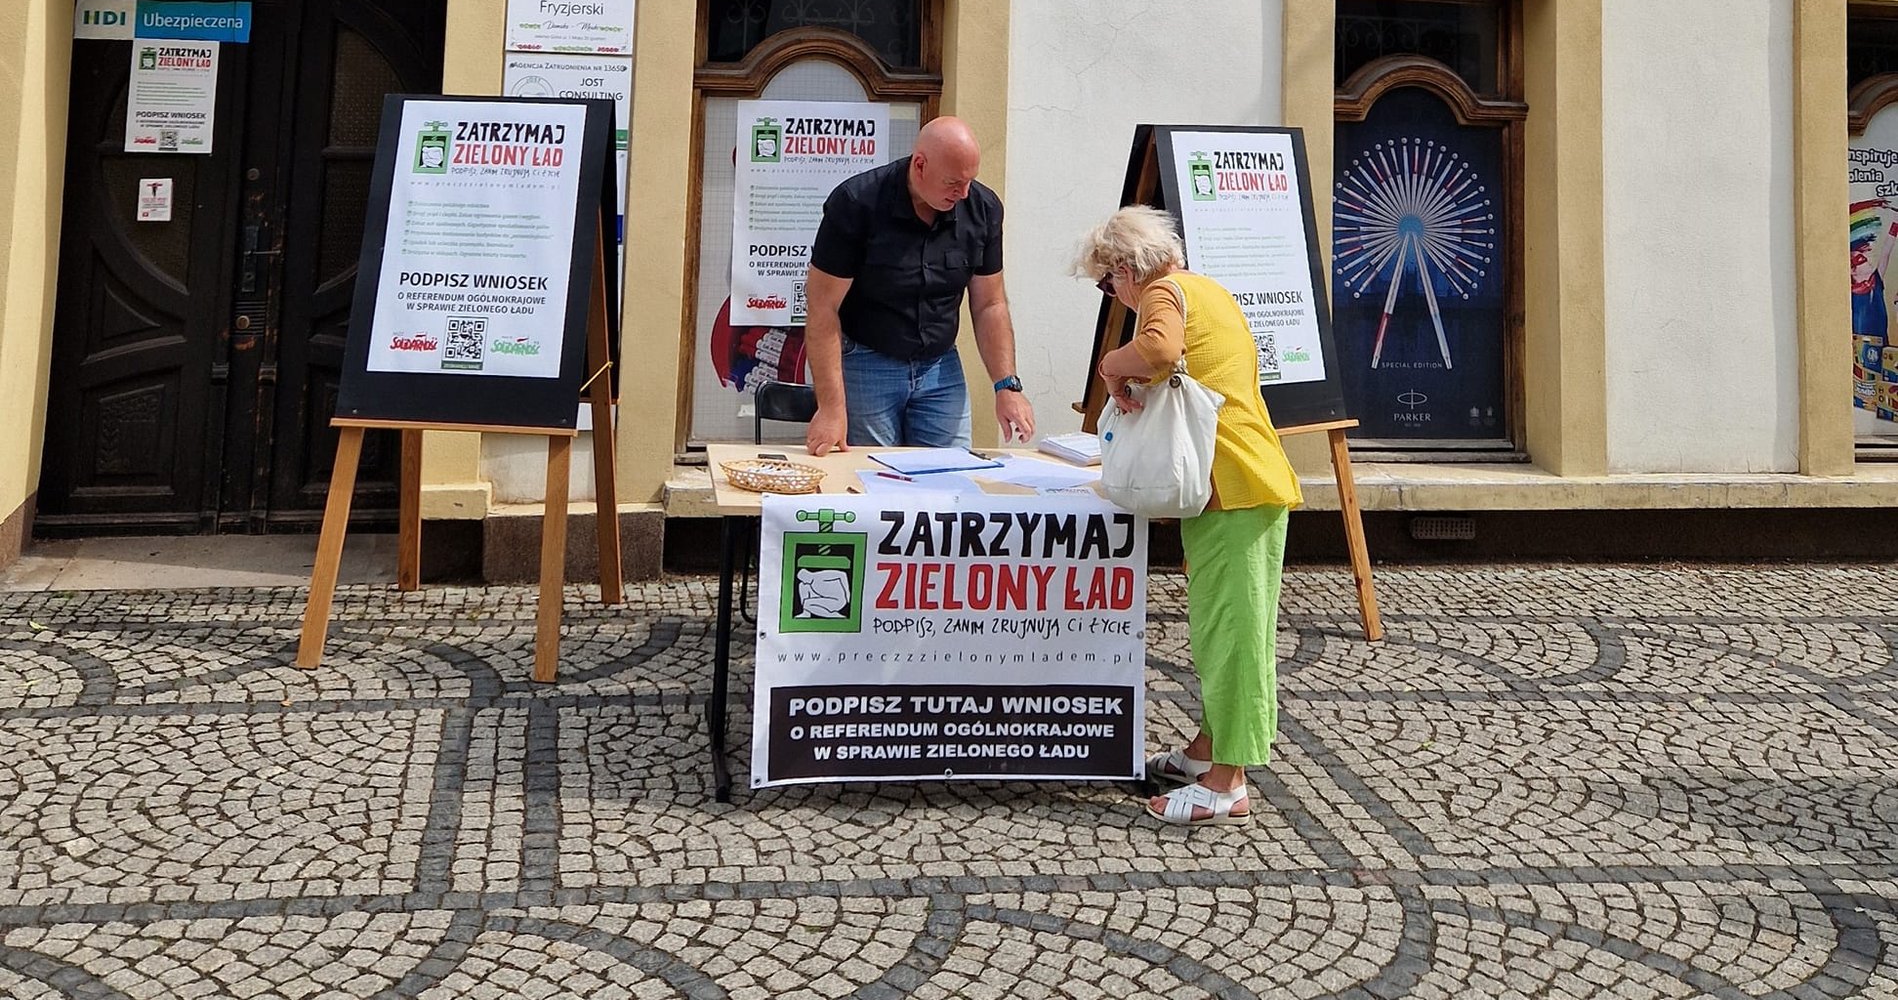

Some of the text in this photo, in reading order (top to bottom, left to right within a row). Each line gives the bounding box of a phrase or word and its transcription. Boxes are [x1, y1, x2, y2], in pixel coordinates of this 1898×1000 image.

[540, 0, 604, 16] Fryzjerski
[83, 10, 126, 26] HDI
[158, 47, 212, 58] ZATRZYMAJ
[158, 57, 194, 67] ZIELONY
[580, 78, 604, 87] JOST
[559, 91, 624, 100] CONSULTING
[136, 111, 169, 119] PODPISZ
[456, 122, 565, 144] ZATRZYMAJ
[785, 118, 875, 136] ZATRZYMAJ
[785, 136, 875, 155] ZIELONY ŁAD
[453, 144, 563, 166] ZIELONY ŁAD
[1214, 151, 1284, 171] ZATRZYMAJ
[1848, 148, 1898, 168] nspiruje
[1217, 172, 1288, 191] ZIELONY ŁAD
[749, 245, 807, 256] PODPISZ
[399, 272, 548, 291] PODPISZ WNIOSEK
[398, 292, 546, 305] O REFERENDUM OGÓLNOKRAJOWE
[1256, 291, 1304, 305] WNIOSEK
[417, 303, 456, 312] SPRAWIE
[458, 304, 508, 313] ZIELONEGO
[510, 306, 535, 315] ŁADU
[1393, 413, 1432, 421] PARKER
[877, 510, 1135, 560] ZATRZYMAJ
[875, 563, 1135, 611] ZIELONY ŁAD
[873, 617, 936, 638] PODPISZ,
[943, 617, 984, 635] ZANIM
[991, 617, 1060, 639] ZRUJNUJĄ
[1089, 617, 1132, 635] ŻYCIE
[777, 650, 1134, 664] www.preczzzielonymladem.pl
[788, 696, 1124, 717] PODPISZ TUTAJ WNIOSEK
[790, 720, 1115, 741] O REFERENDUM OGÓLNOKRAJOWE
[813, 744, 1090, 761] W SPRAWIE ZIELONEGO ŁADU
